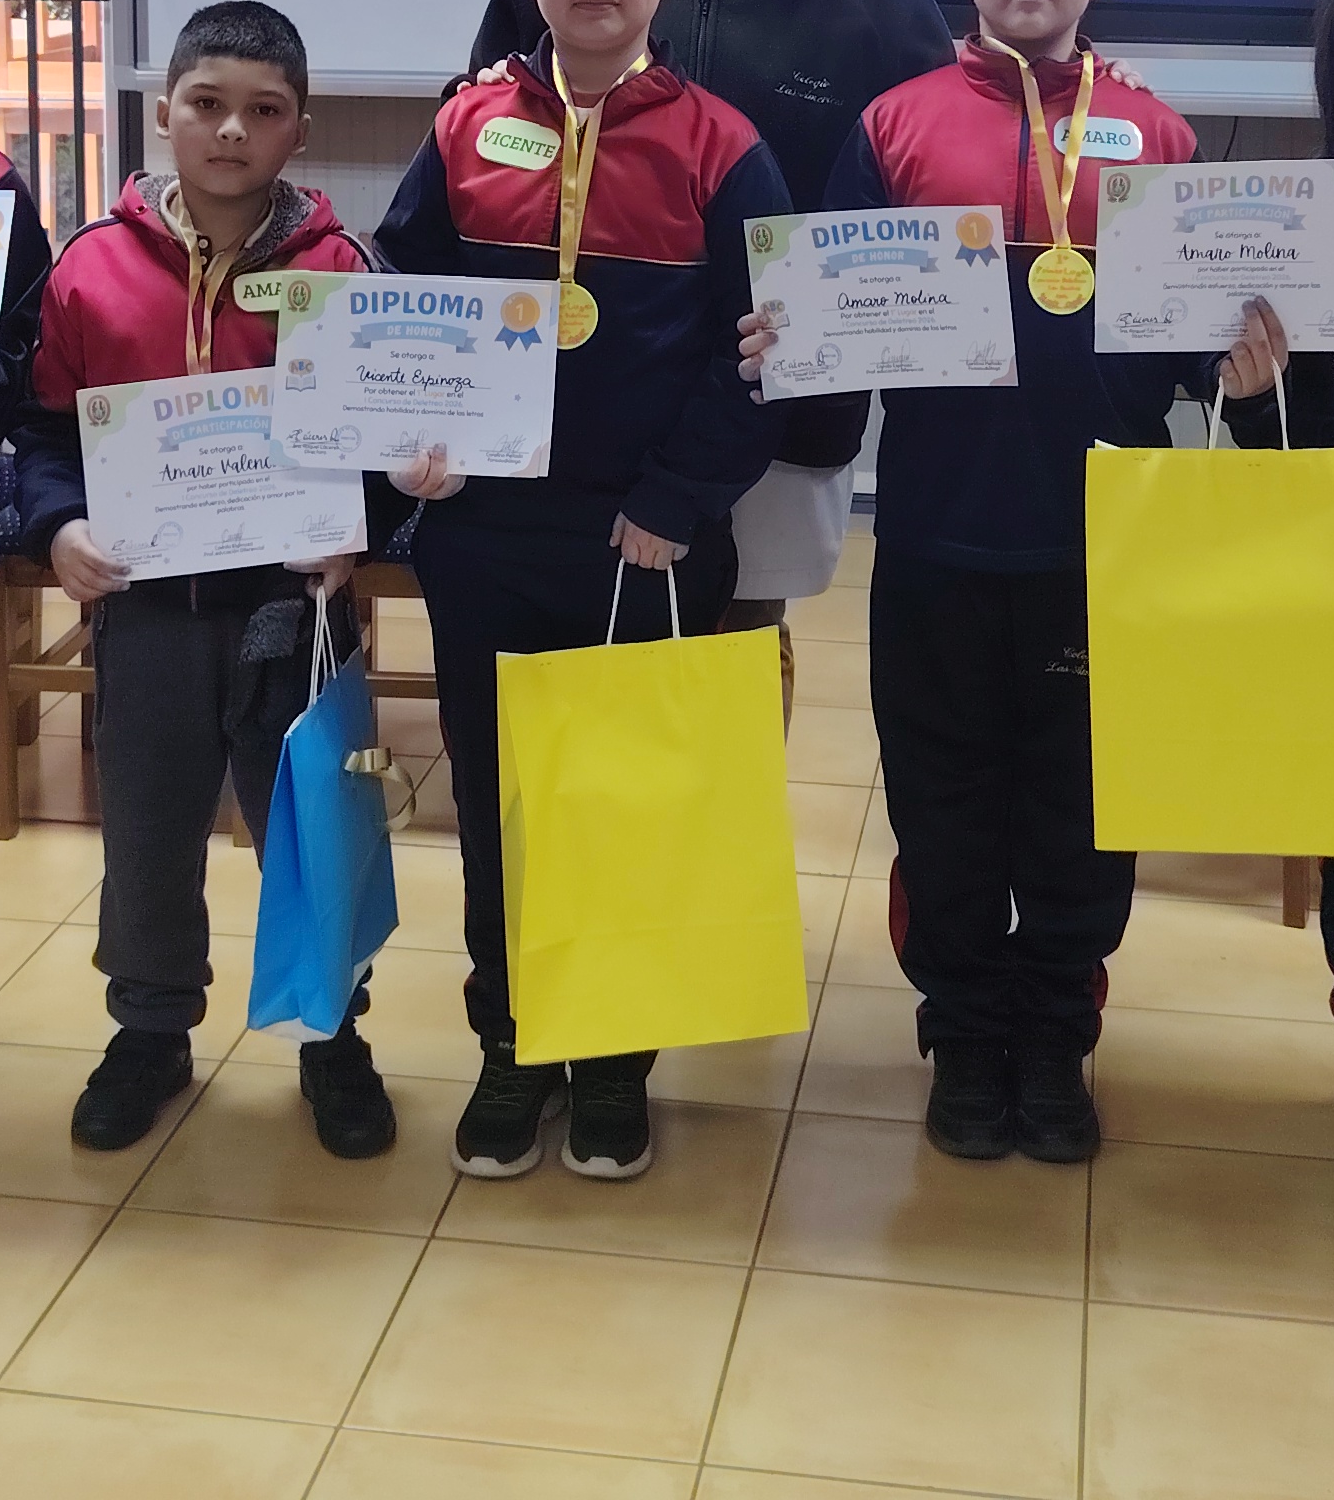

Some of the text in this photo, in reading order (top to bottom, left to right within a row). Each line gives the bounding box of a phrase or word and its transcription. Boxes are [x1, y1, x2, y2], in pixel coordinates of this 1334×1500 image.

[484, 129, 556, 159] VICENTE
[1175, 175, 1314, 203] DIPLOMA
[811, 219, 939, 249] DIPLOMA
[969, 221, 978, 239] 1
[1176, 241, 1301, 261] Amaro Molina
[243, 282, 282, 299] AMA
[350, 291, 484, 321] DIPLOMA
[516, 303, 523, 321] 1
[387, 325, 443, 338] DE HONOR
[390, 351, 400, 359] Se
[356, 364, 475, 393] Vicente Espinoza
[153, 384, 274, 422] DIPLOM
[159, 463, 216, 482] Amaro
